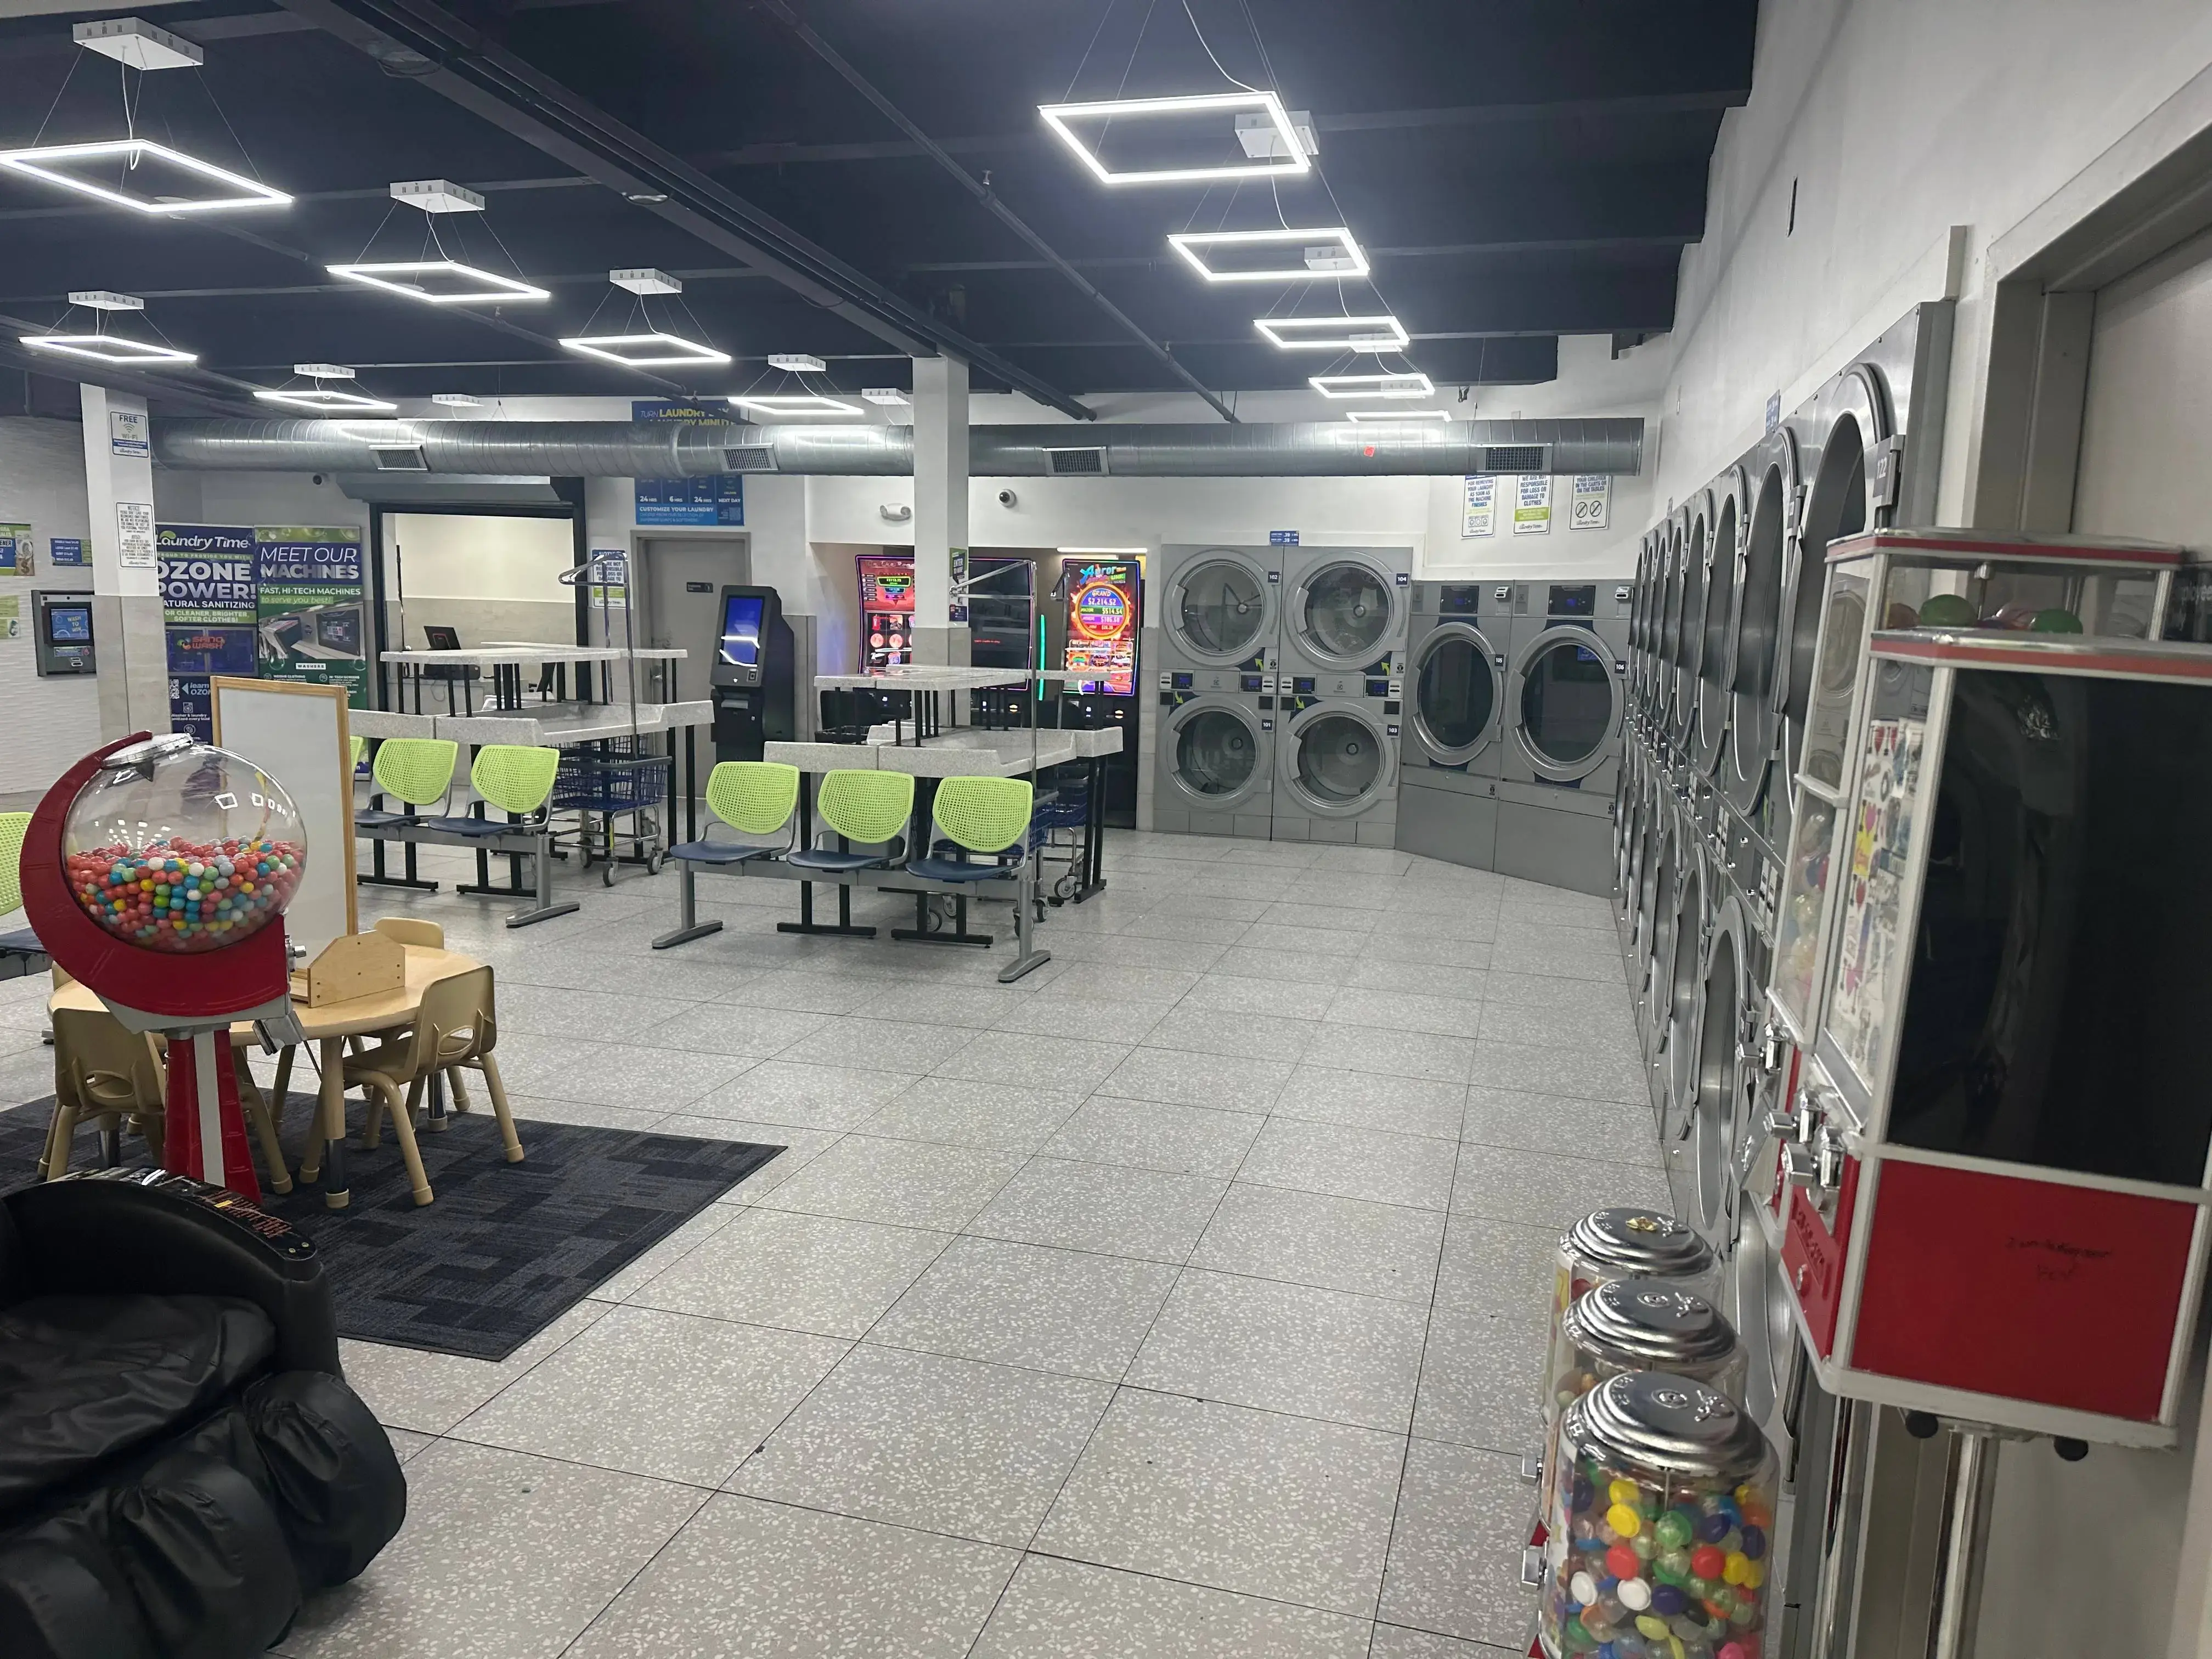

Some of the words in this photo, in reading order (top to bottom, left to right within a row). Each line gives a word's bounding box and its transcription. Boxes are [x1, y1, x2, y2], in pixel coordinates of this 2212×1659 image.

[119, 415, 138, 423] FREE
[1877, 456, 1887, 479] 122
[215, 537, 249, 548] Time
[261, 547, 312, 561] MEET
[314, 548, 357, 562] OUR
[260, 564, 359, 579] MACHINES
[1088, 597, 1116, 606] $2,214.52
